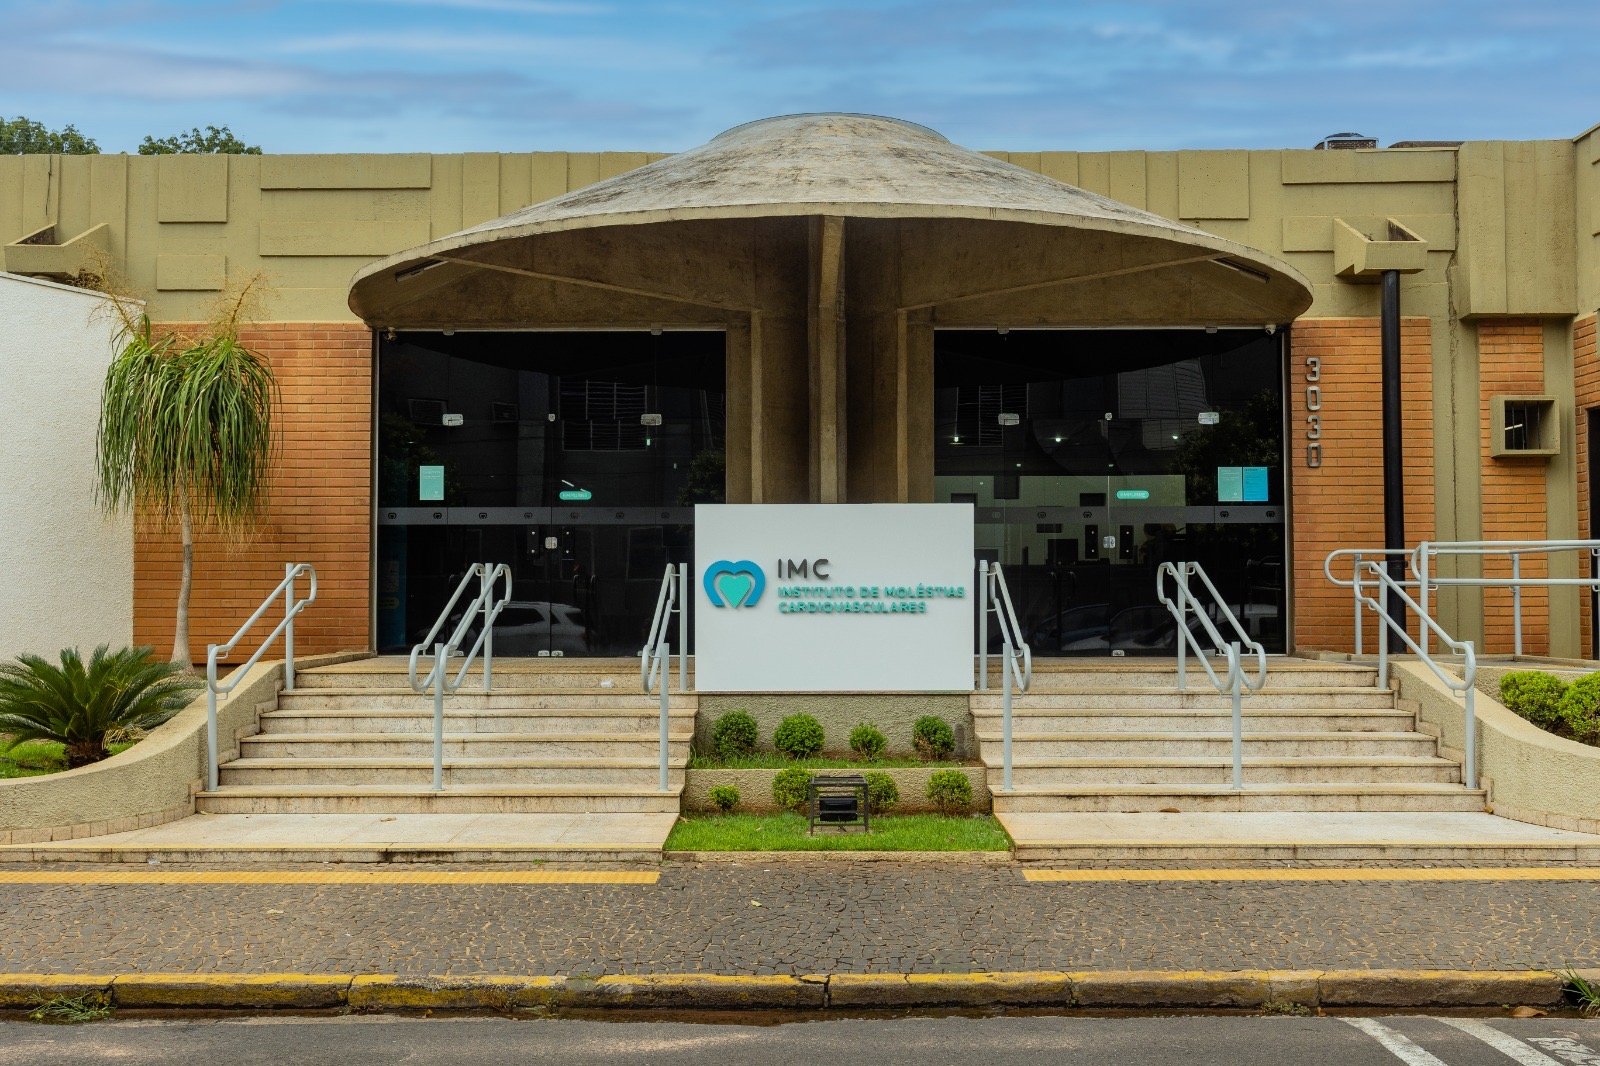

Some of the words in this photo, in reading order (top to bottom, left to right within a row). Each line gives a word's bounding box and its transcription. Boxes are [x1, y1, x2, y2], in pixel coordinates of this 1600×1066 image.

[1306, 357, 1321, 467] 3030
[778, 559, 829, 580] IMC
[778, 586, 855, 598] INSTITUTO
[860, 586, 879, 598] DE
[884, 583, 965, 598] MOLÉSTIAS
[779, 602, 926, 613] CARDIOVASCULARES
